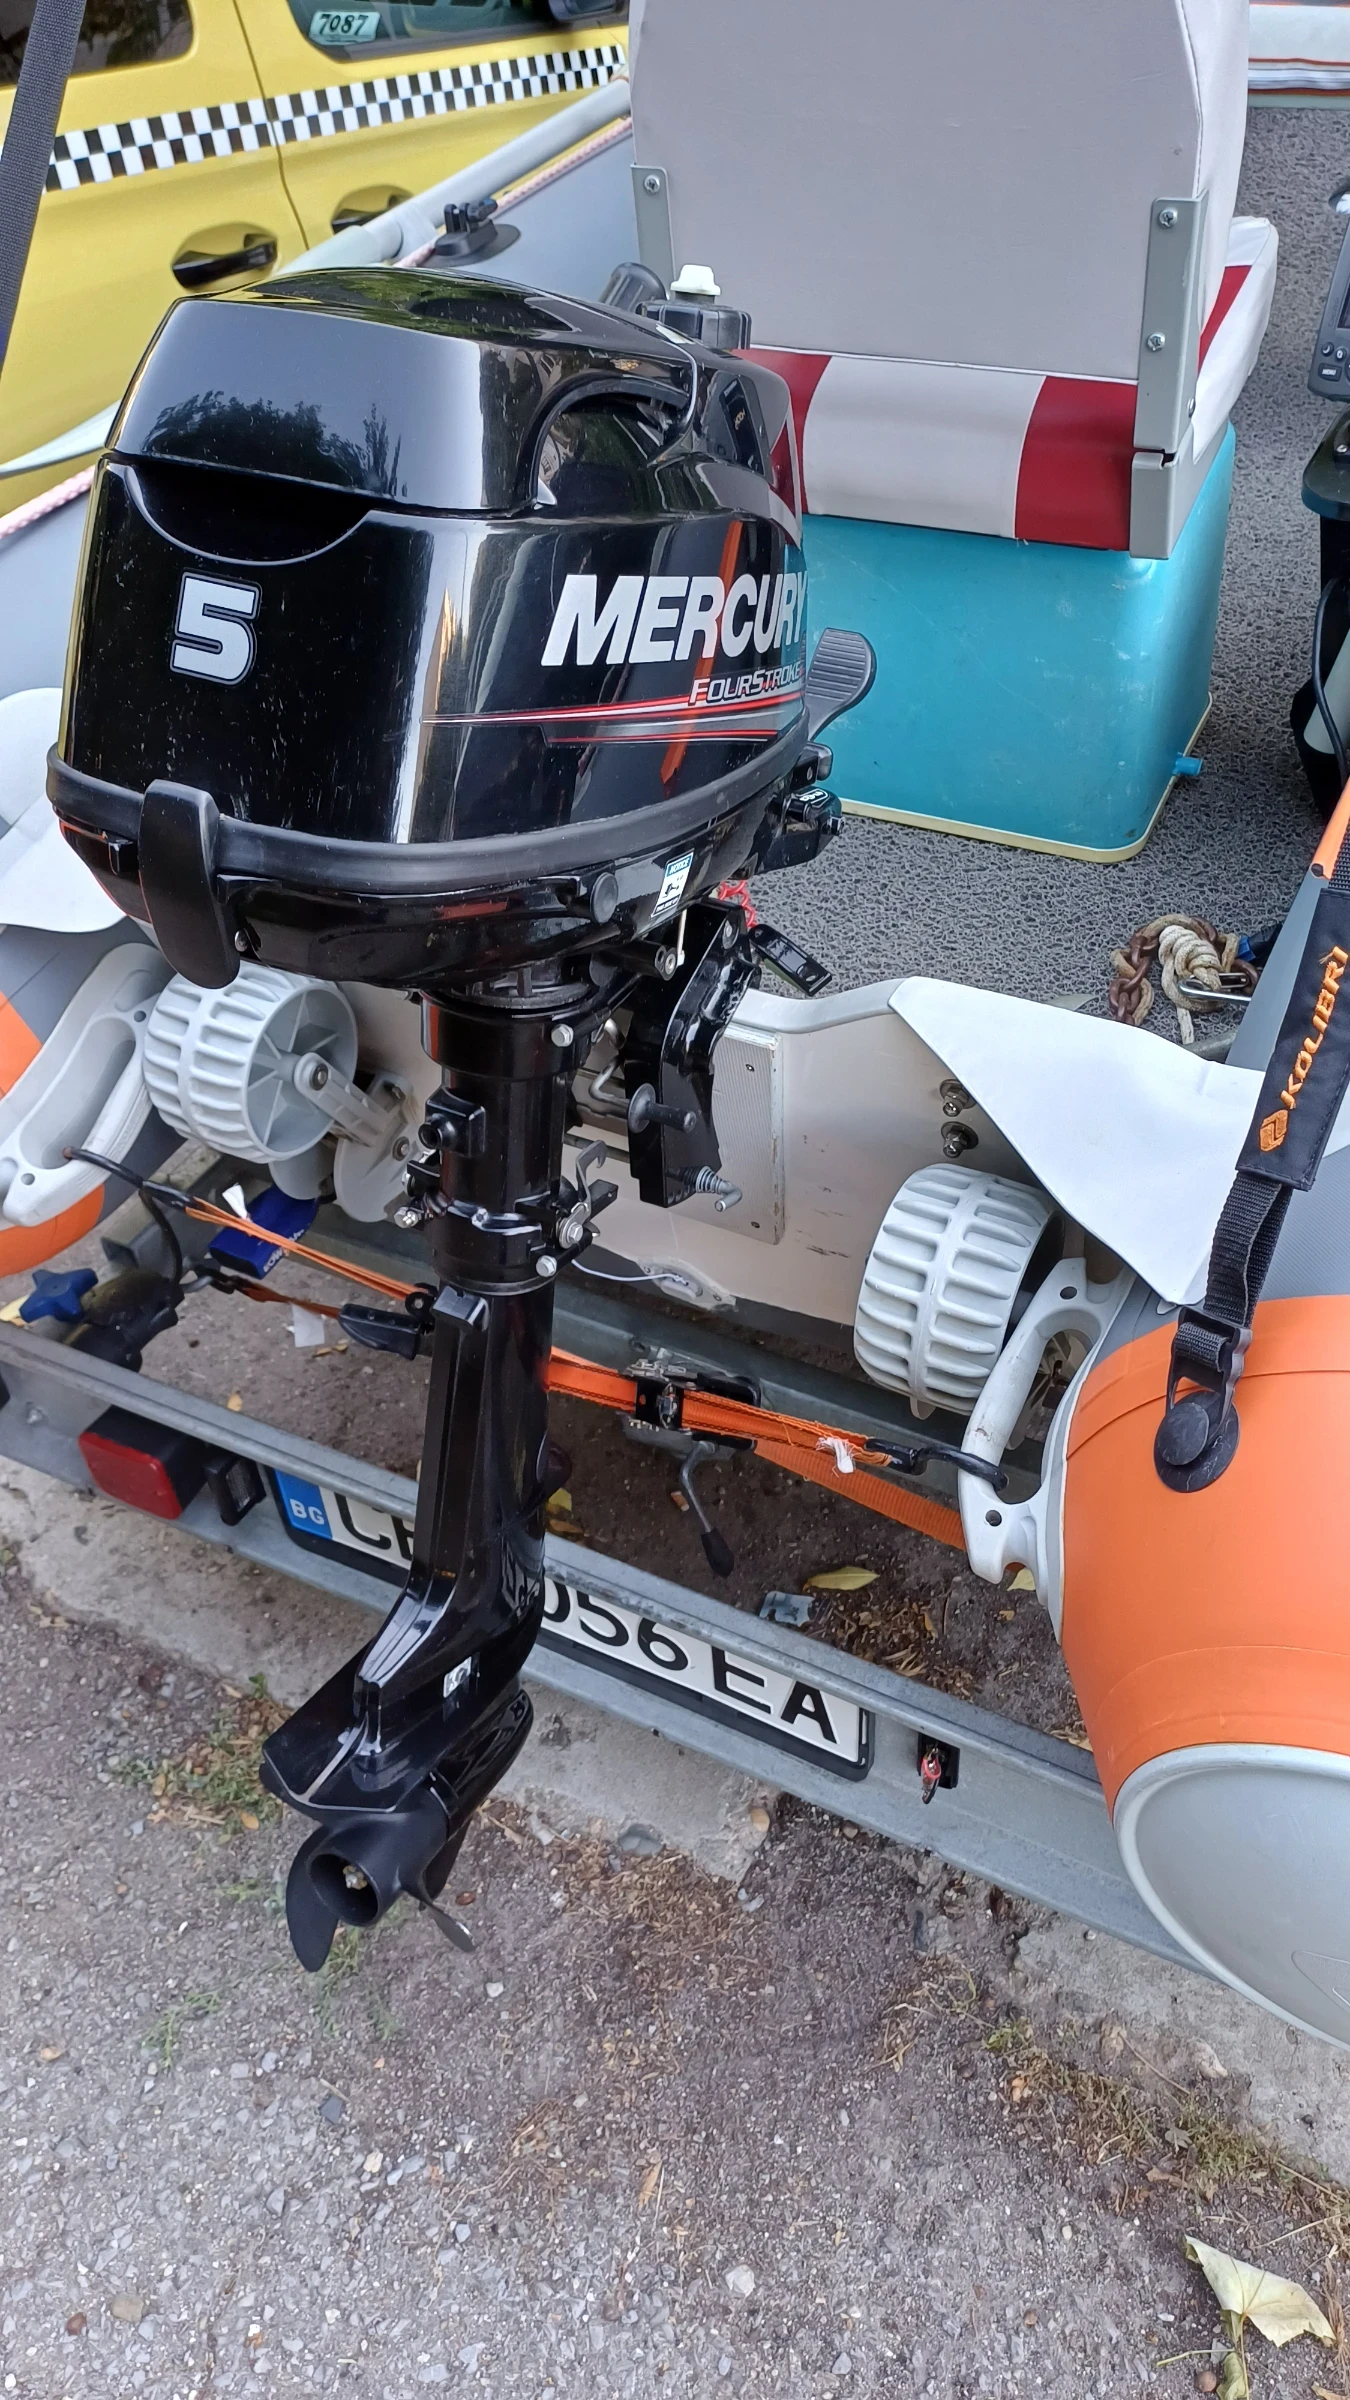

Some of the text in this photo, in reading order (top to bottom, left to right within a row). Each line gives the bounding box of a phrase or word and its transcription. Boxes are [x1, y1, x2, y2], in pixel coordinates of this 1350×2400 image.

[319, 13, 369, 36] 7087
[170, 571, 260, 686] 5
[541, 571, 807, 666] MERCURY
[1280, 946, 1348, 1110] KOLIBRI
[289, 1498, 325, 1525] BG
[711, 1646, 838, 1744] EA
